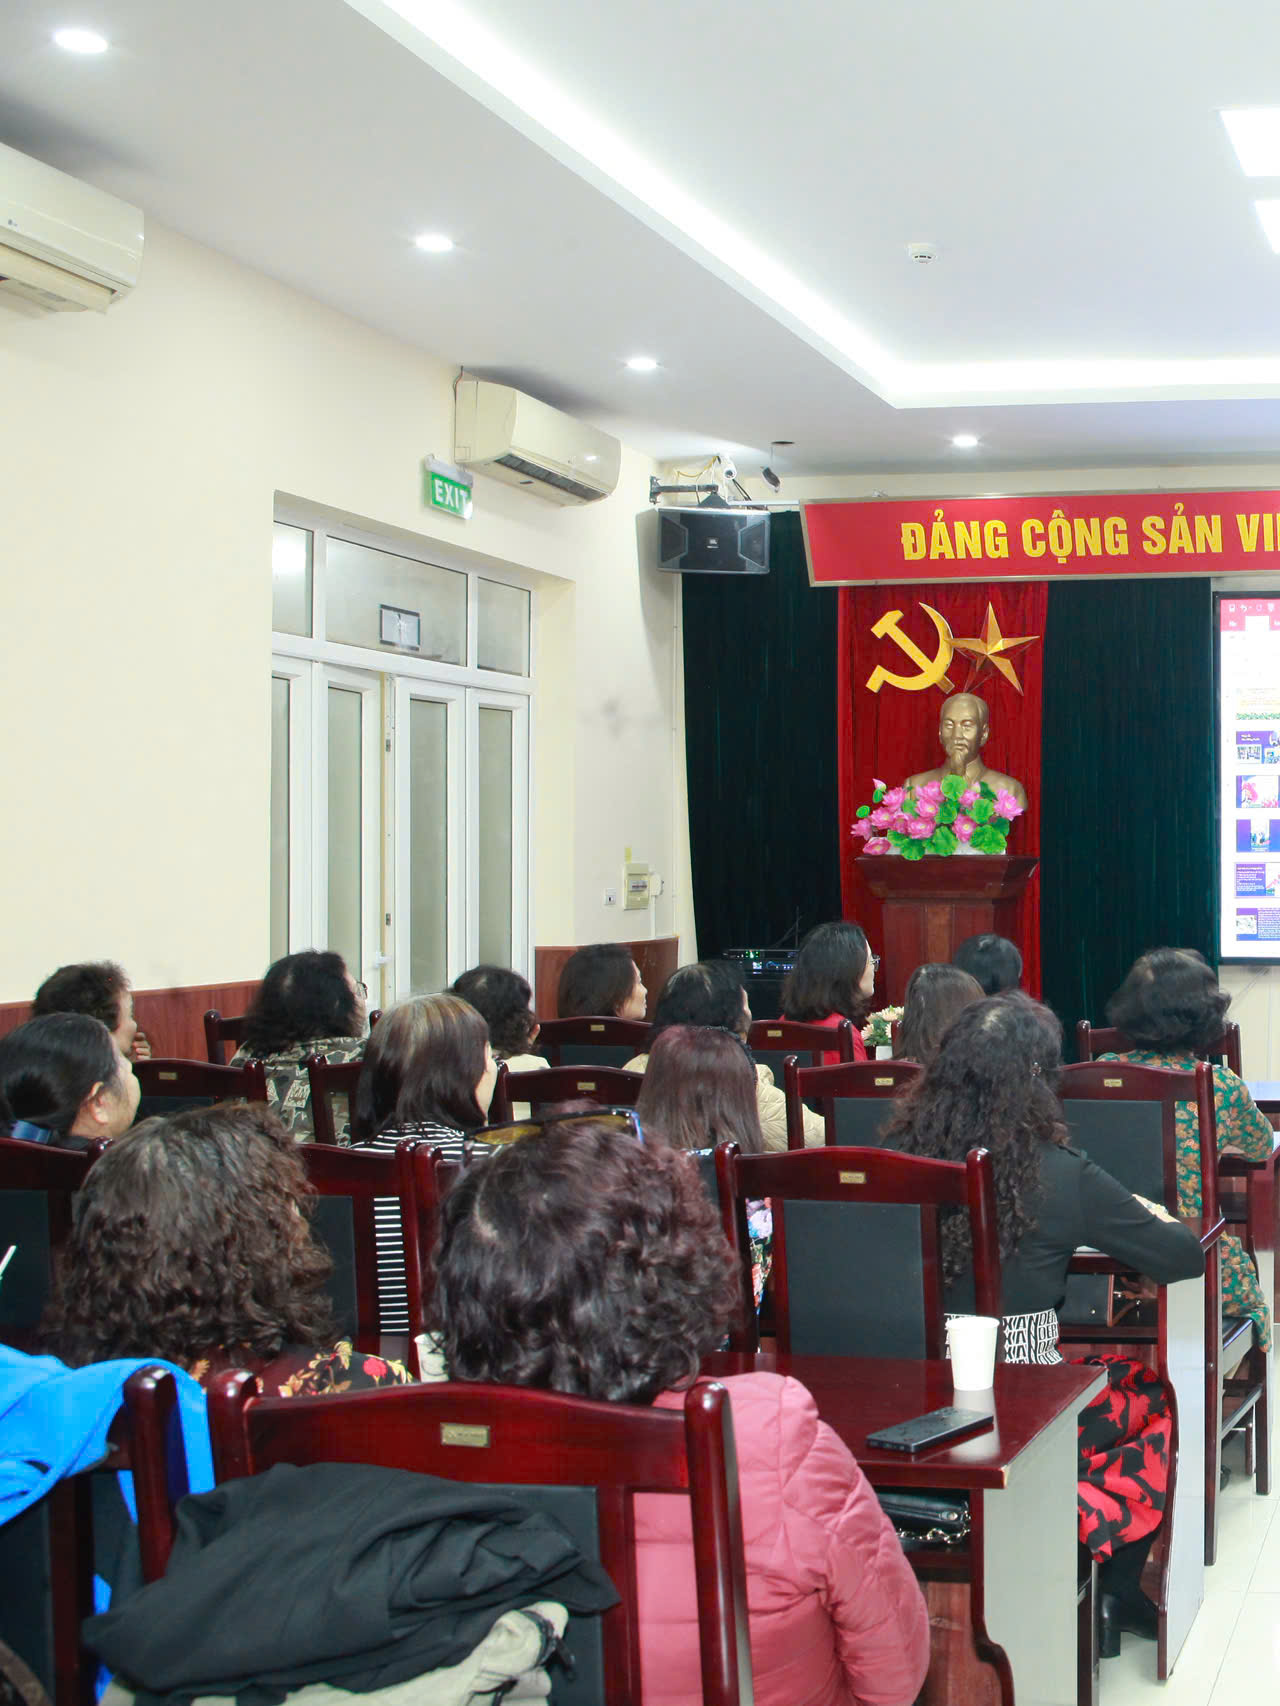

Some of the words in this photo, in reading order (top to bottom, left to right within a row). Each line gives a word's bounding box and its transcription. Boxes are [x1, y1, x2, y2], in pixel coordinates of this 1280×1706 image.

[434, 479, 468, 510] EXIT
[901, 509, 1009, 561] ĐẢNG
[1021, 509, 1129, 564] CỘNG
[1143, 503, 1223, 555] SẢN
